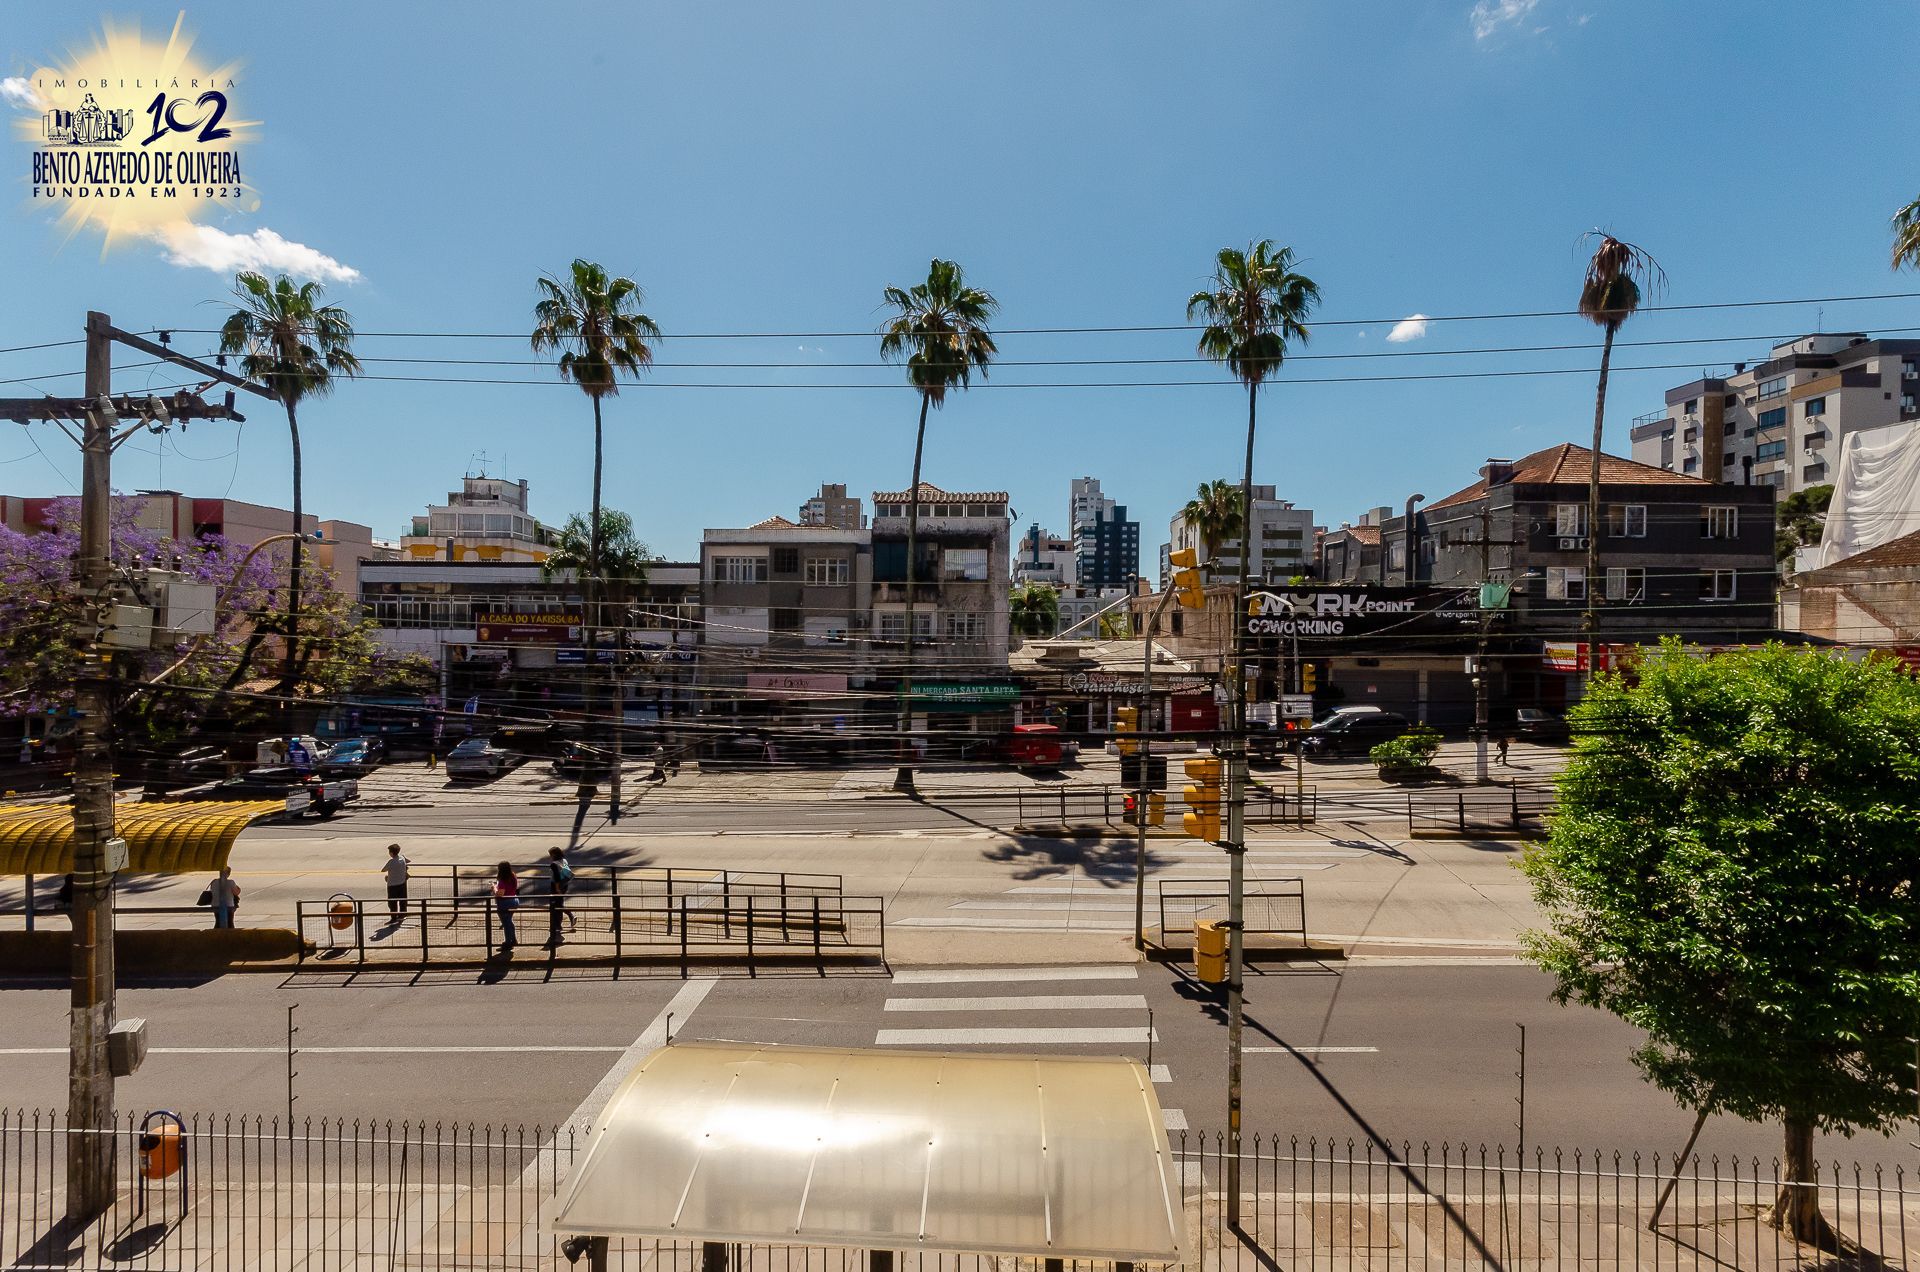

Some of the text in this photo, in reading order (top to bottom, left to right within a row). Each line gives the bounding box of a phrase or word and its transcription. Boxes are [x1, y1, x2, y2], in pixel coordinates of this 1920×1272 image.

[480, 615, 486, 623] A
[489, 614, 512, 624] CASA
[515, 615, 528, 623] DO
[1248, 620, 1344, 634] COWORKING
[960, 686, 990, 694] SANTA
